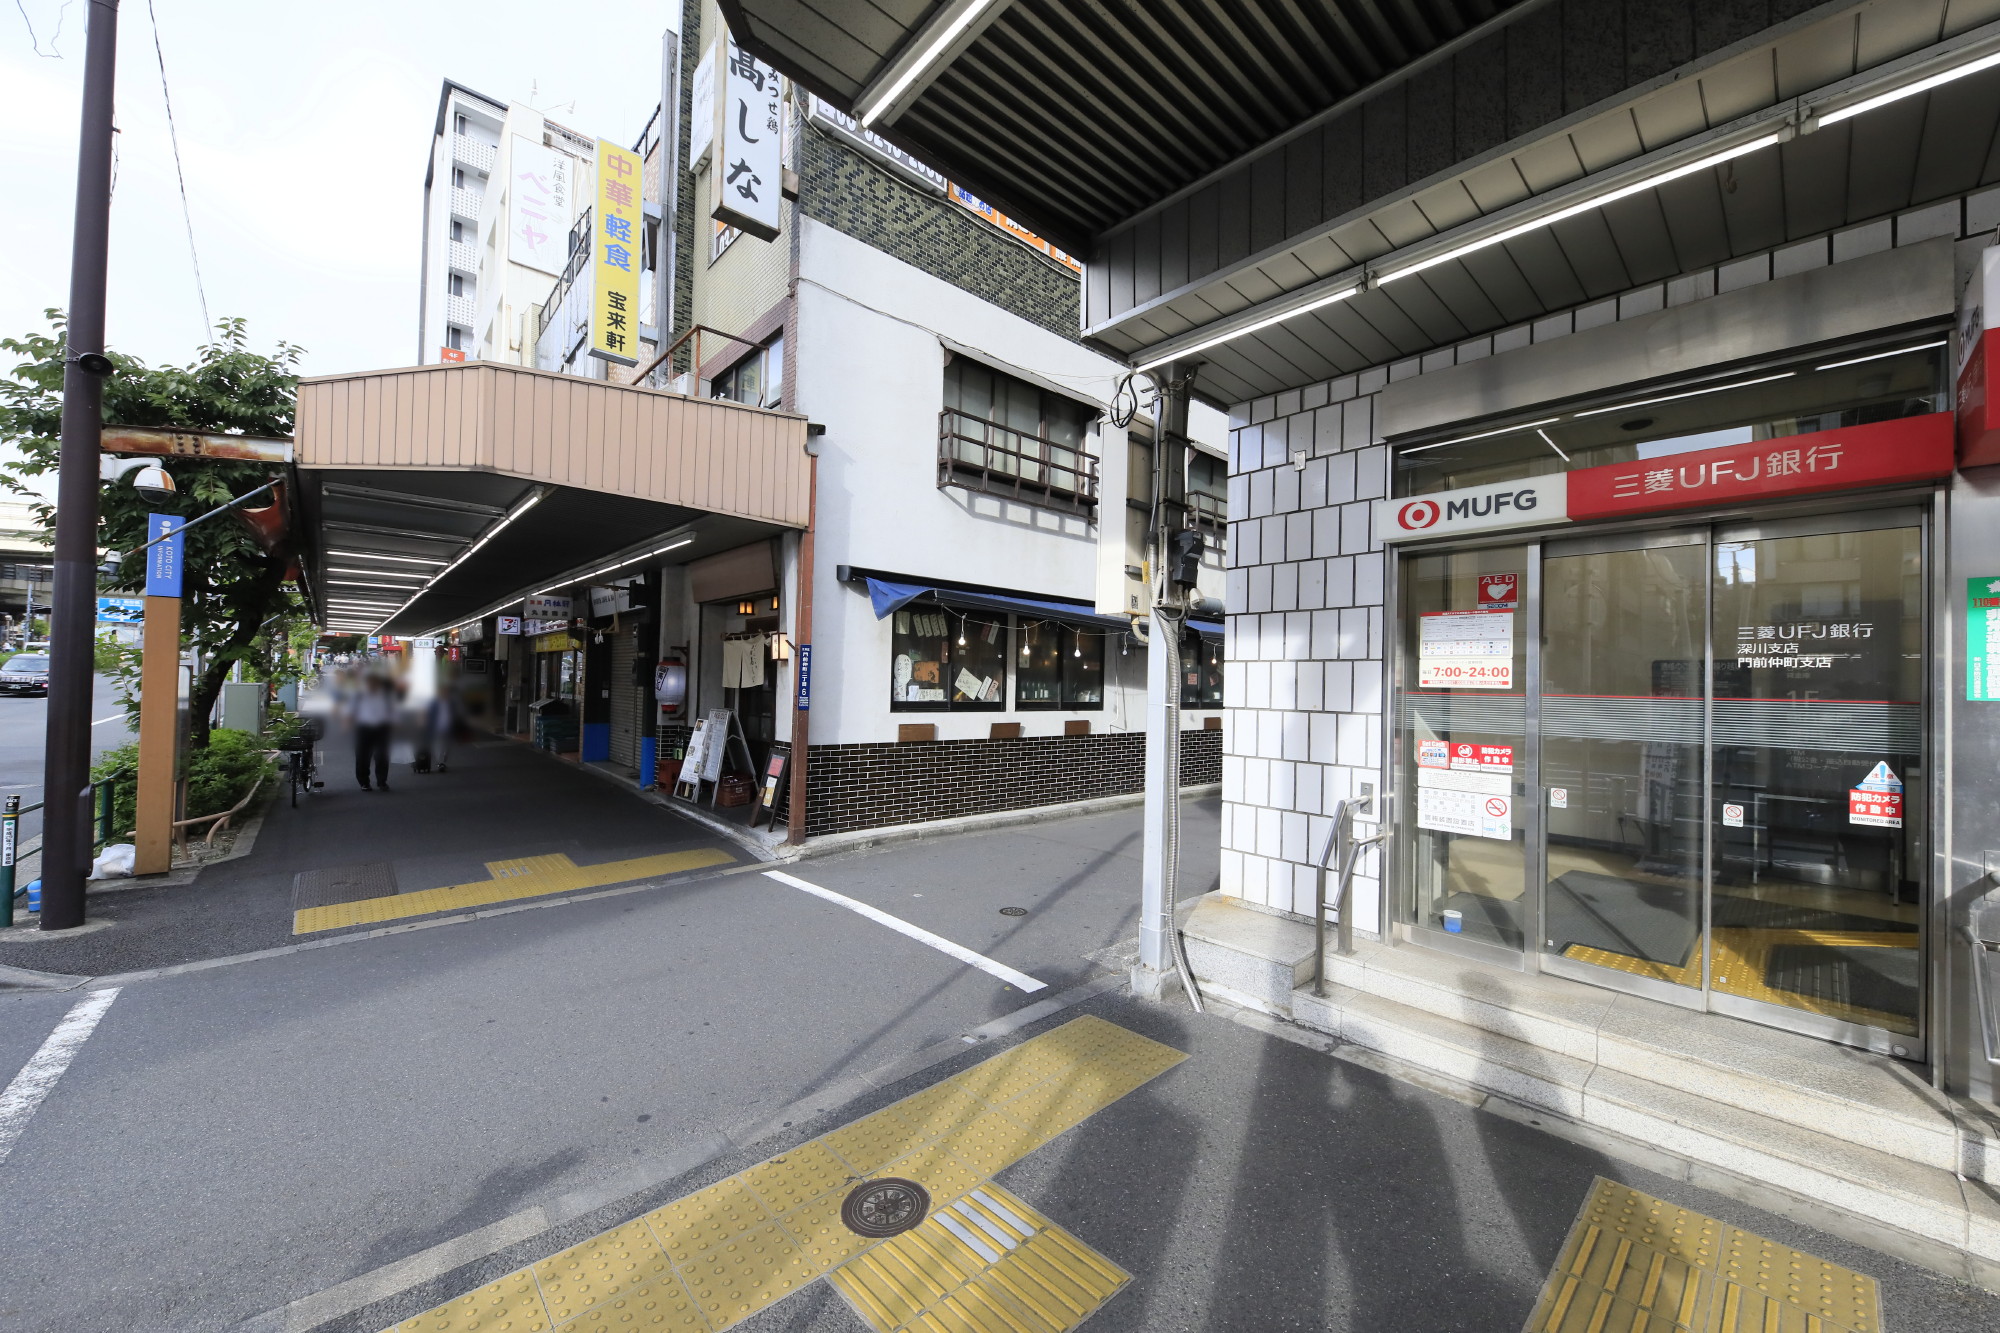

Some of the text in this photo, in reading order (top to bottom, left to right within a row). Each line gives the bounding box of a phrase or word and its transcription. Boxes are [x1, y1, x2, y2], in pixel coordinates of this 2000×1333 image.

[553, 157, 566, 208] 洋風食堂
[517, 171, 552, 250] ベニヤ
[604, 154, 633, 272] 中華・軽食
[606, 290, 627, 352] 宝来軒
[1612, 443, 1844, 498] 三菱UFJ銀行
[1447, 489, 1537, 521] MUFG
[165, 546, 174, 580] KOTO CITY
[1481, 574, 1515, 585] AED
[1737, 622, 1874, 640] 三菱UFJ銀行
[1737, 642, 1800, 655] 深川支店
[1737, 656, 1832, 669] 門前仲町支店
[801, 688, 807, 696] 6
[1481, 746, 1512, 756] 防犯カメラ
[1483, 755, 1510, 765] 作動中
[1850, 792, 1901, 804] 防犯カメラ
[1855, 803, 1896, 816] 作動中
[1851, 816, 1884, 824] MONITORED
